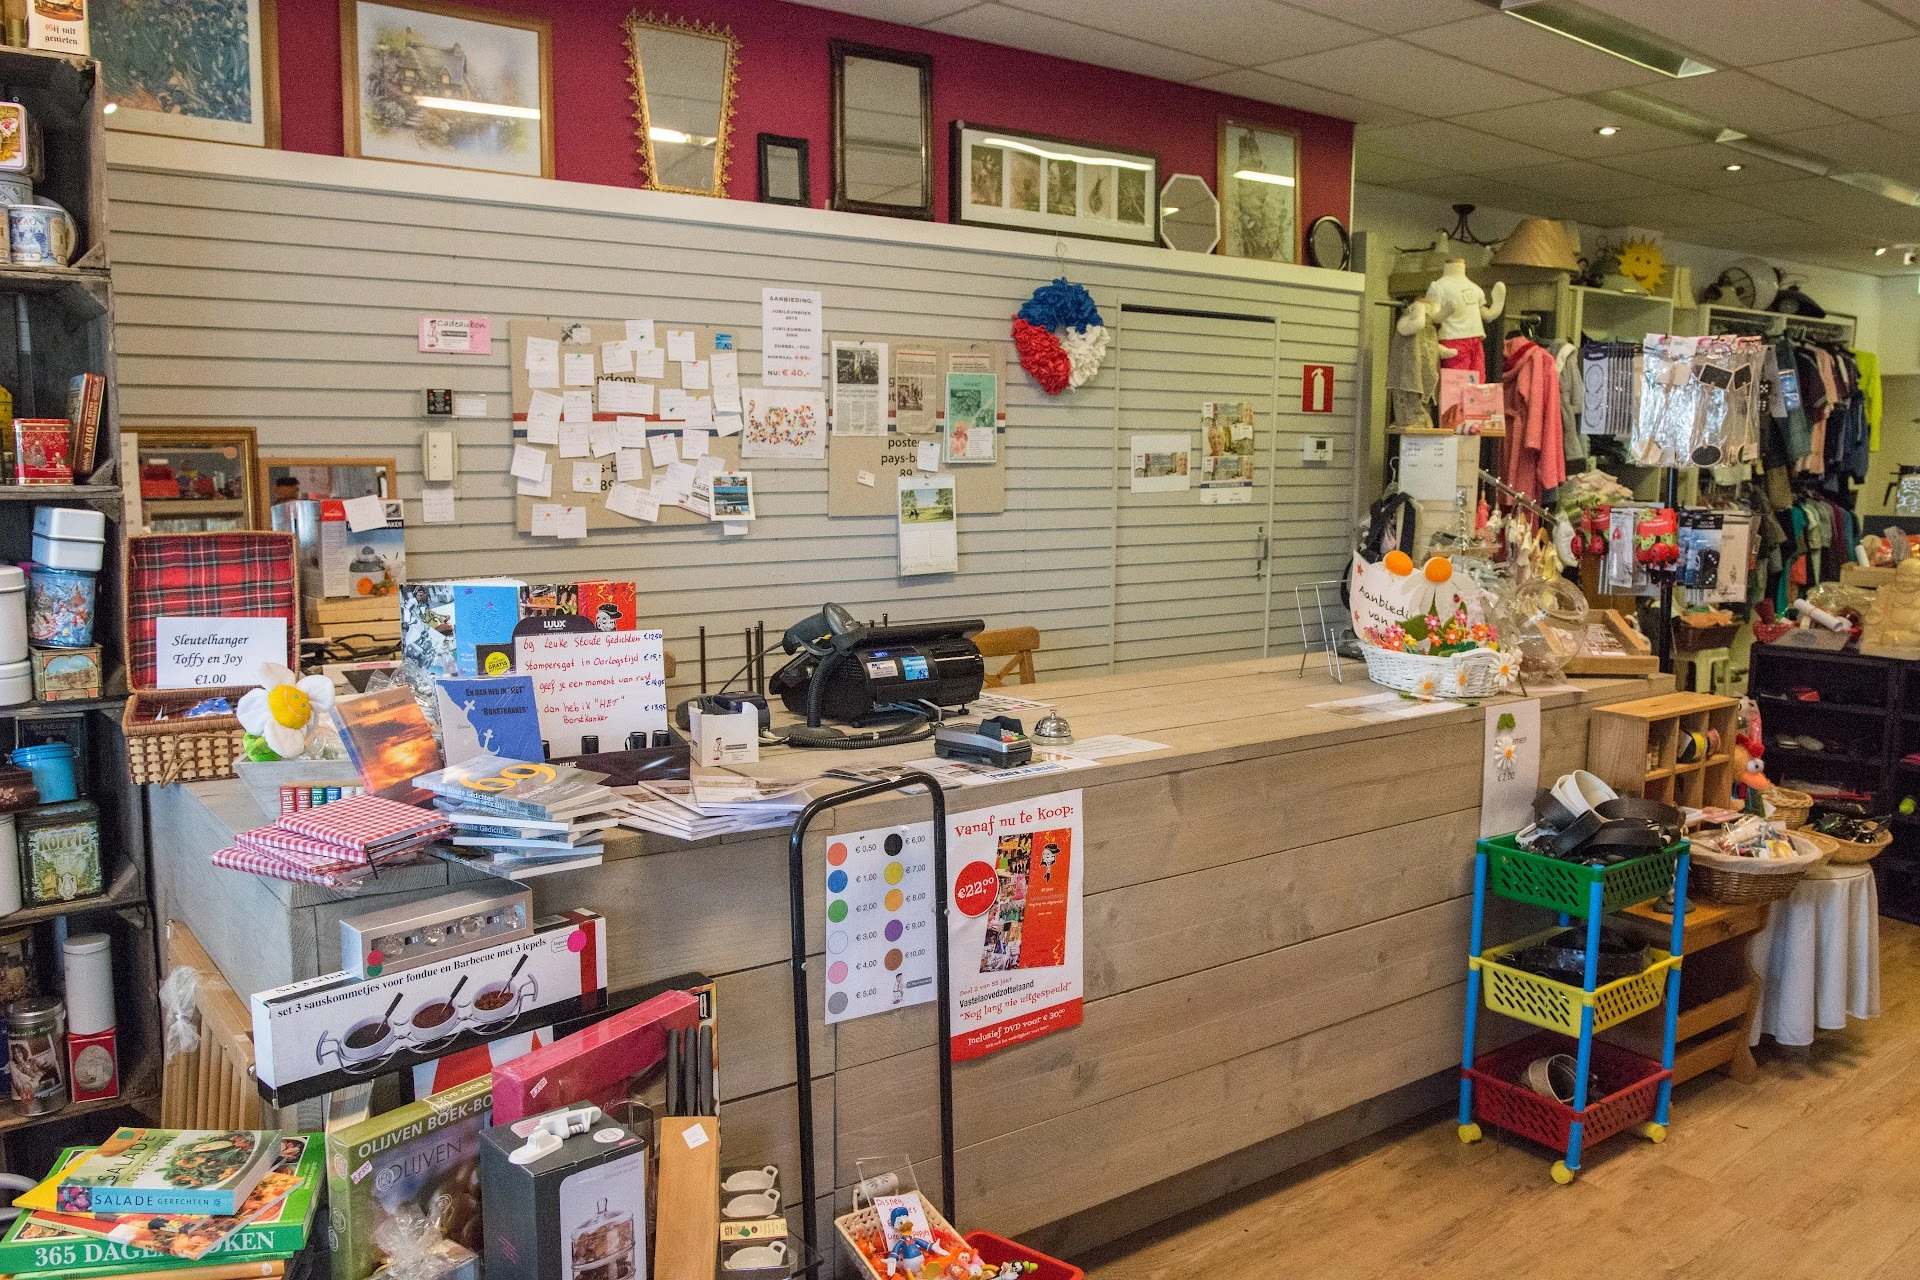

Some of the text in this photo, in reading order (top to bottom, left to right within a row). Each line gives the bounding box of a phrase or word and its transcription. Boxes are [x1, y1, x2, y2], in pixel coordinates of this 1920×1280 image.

[44, 35, 78, 45] genieten
[769, 296, 813, 304] AANBIEDING:
[437, 319, 486, 329] Cadeaubon
[888, 438, 920, 450] poste
[1368, 610, 1389, 626] van
[544, 620, 566, 628] LUUX
[172, 634, 249, 648] Sleutelhanger
[574, 634, 602, 648] Stoute
[605, 632, 641, 647] Gedichten
[172, 652, 243, 668] Toffy en Joy
[488, 661, 508, 670] GRATIS
[524, 653, 639, 672] Stampersgat in Oorlogstijd
[194, 674, 226, 685] €1.00
[586, 675, 616, 686] moment
[618, 676, 633, 684] van
[544, 704, 560, 714] dan
[562, 701, 579, 713] heb
[594, 695, 625, 709] "HET"
[562, 714, 609, 725] Borstkanker
[466, 790, 494, 801] Gedichten
[1000, 817, 1015, 827] nu
[1020, 810, 1032, 824] te
[1037, 806, 1074, 820] koop:
[38, 832, 90, 852] KOFFIE
[905, 835, 926, 845] € 6,00
[863, 843, 877, 852] 0,50
[905, 864, 926, 874] € 7,00
[863, 873, 877, 882] 1,00
[912, 893, 926, 901] 8,00
[863, 902, 877, 911] 2,00
[905, 920, 926, 931] € 9,00
[863, 932, 877, 940] 3,00
[863, 960, 877, 969] 4,00
[277, 938, 547, 1018] set 3 sauskommetjes voor fondue en Barbecue met 3 lepels
[960, 989, 972, 997] Deel
[1000, 977, 1012, 986] jaar
[856, 988, 877, 999] € 5,00
[960, 980, 1034, 1008] Vastelaovedzottelaand
[960, 981, 1071, 1020] "Nog lang nie uitgespeuld"
[968, 1026, 1002, 1046] Inclusief
[1004, 1023, 1020, 1035] DVD
[1022, 1016, 1041, 1027] voor
[358, 1094, 493, 1157] OLIJVEN BOEK-BO
[98, 1136, 156, 1181] SALADE
[388, 1136, 461, 1185] OLIJVEN
[94, 1195, 209, 1207] SALADE GERECHTEN
[876, 1198, 905, 1206] Disney
[35, 1245, 76, 1266] 365
[83, 1242, 170, 1263] DAGE
